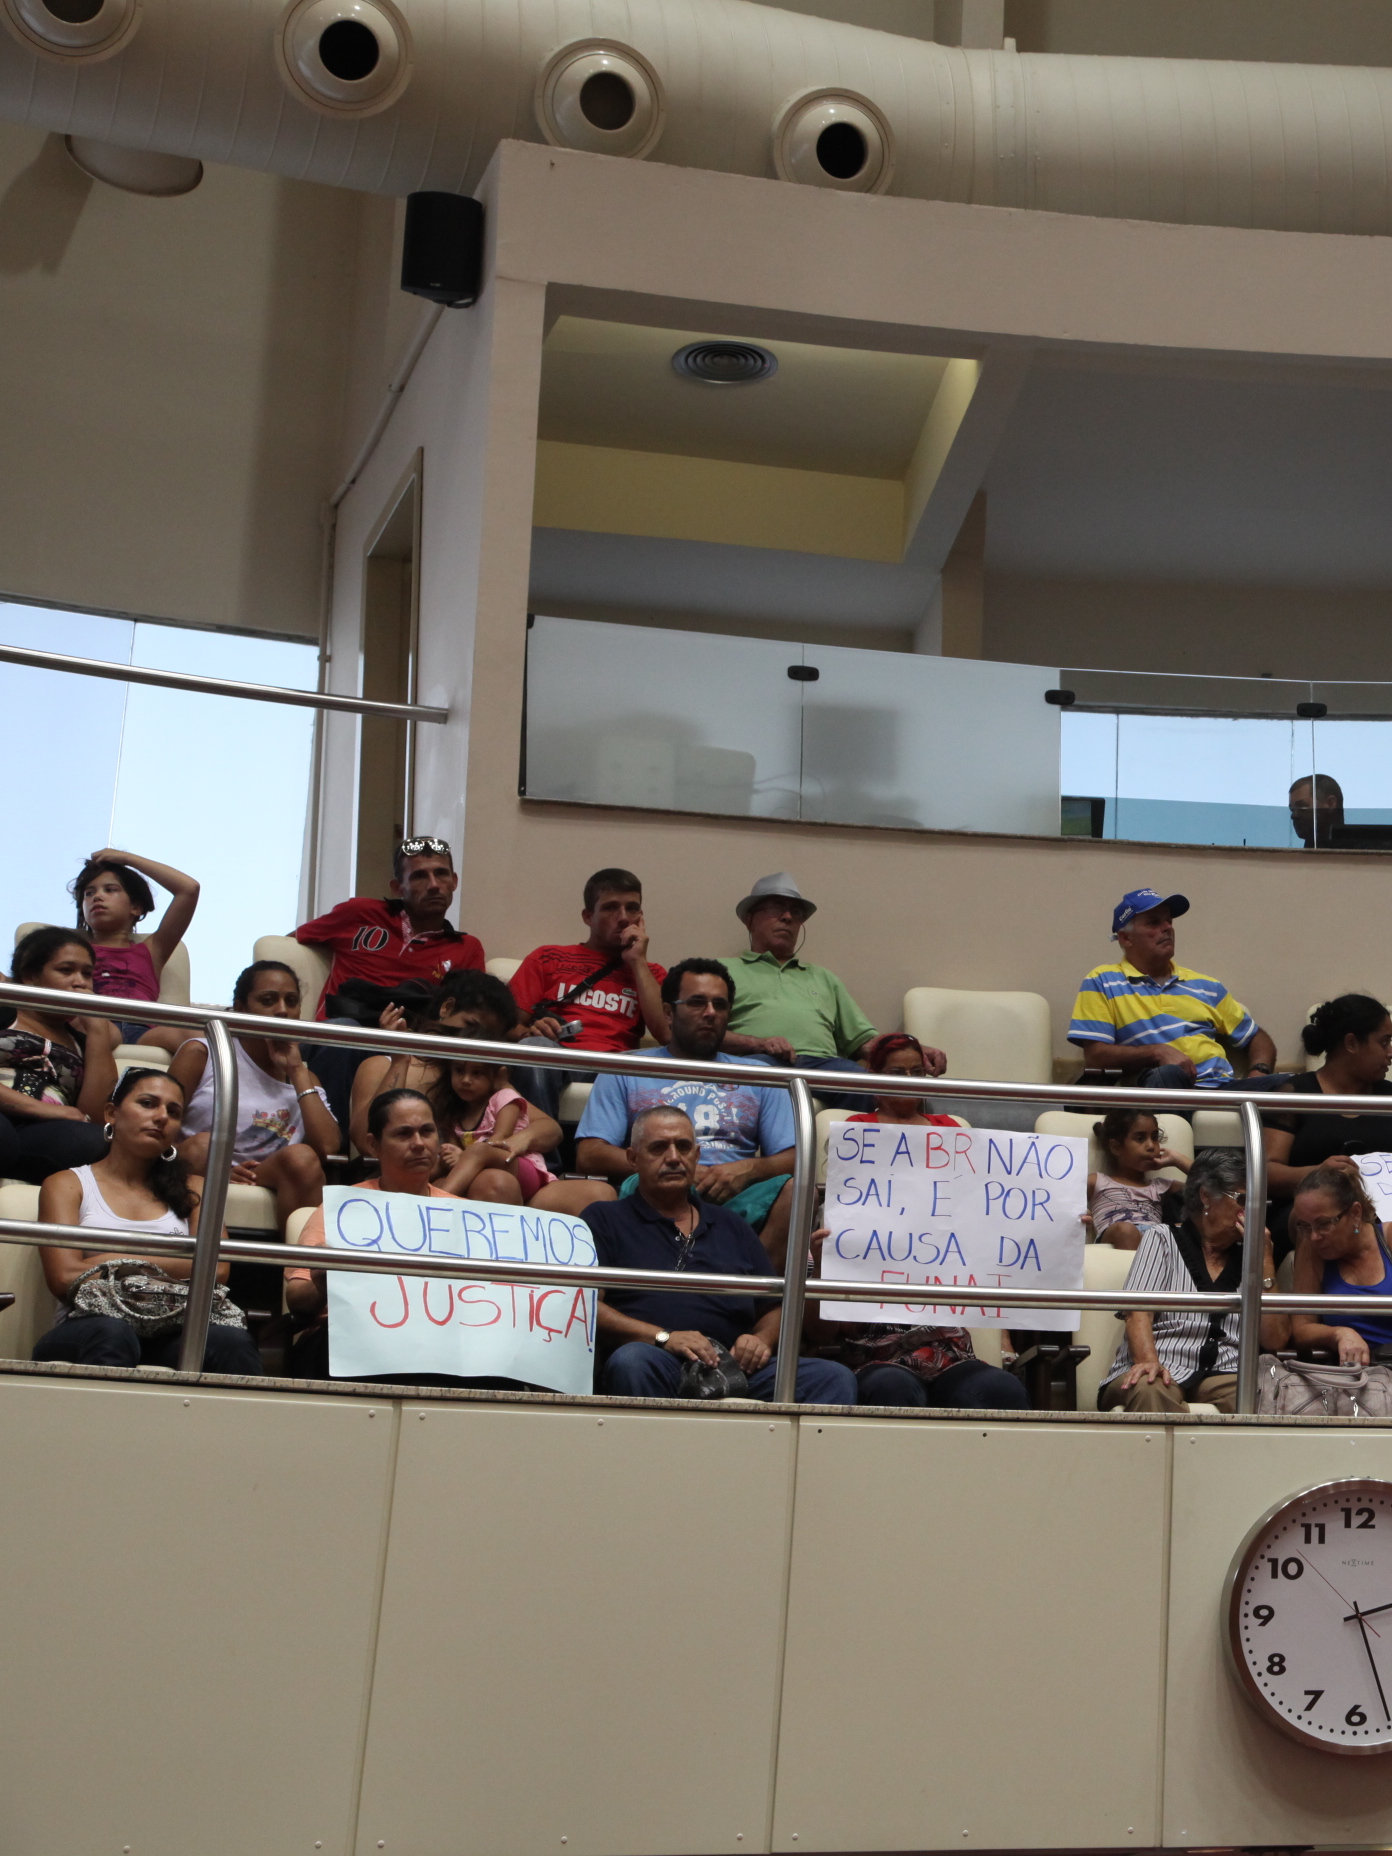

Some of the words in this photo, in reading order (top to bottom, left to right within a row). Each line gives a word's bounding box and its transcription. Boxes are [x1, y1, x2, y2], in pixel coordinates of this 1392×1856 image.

[352, 926, 389, 951] 10
[836, 1127, 881, 1164] SE
[890, 1131, 914, 1168] A
[925, 1131, 976, 1174] BR
[987, 1135, 1075, 1181] NÃO
[984, 1180, 1054, 1223] POR
[337, 1198, 598, 1267] QUEREMOS
[835, 1228, 967, 1266] CAUSA
[996, 1235, 1042, 1272] DA
[370, 1275, 596, 1353] JUSTIÇA!
[1340, 1507, 1376, 1530] 12
[1300, 1523, 1326, 1545] 11
[1266, 1557, 1304, 1581] 10
[1252, 1604, 1275, 1627] 9
[1266, 1652, 1287, 1676] 8
[1303, 1689, 1325, 1712] 7
[1344, 1704, 1368, 1727] 6
